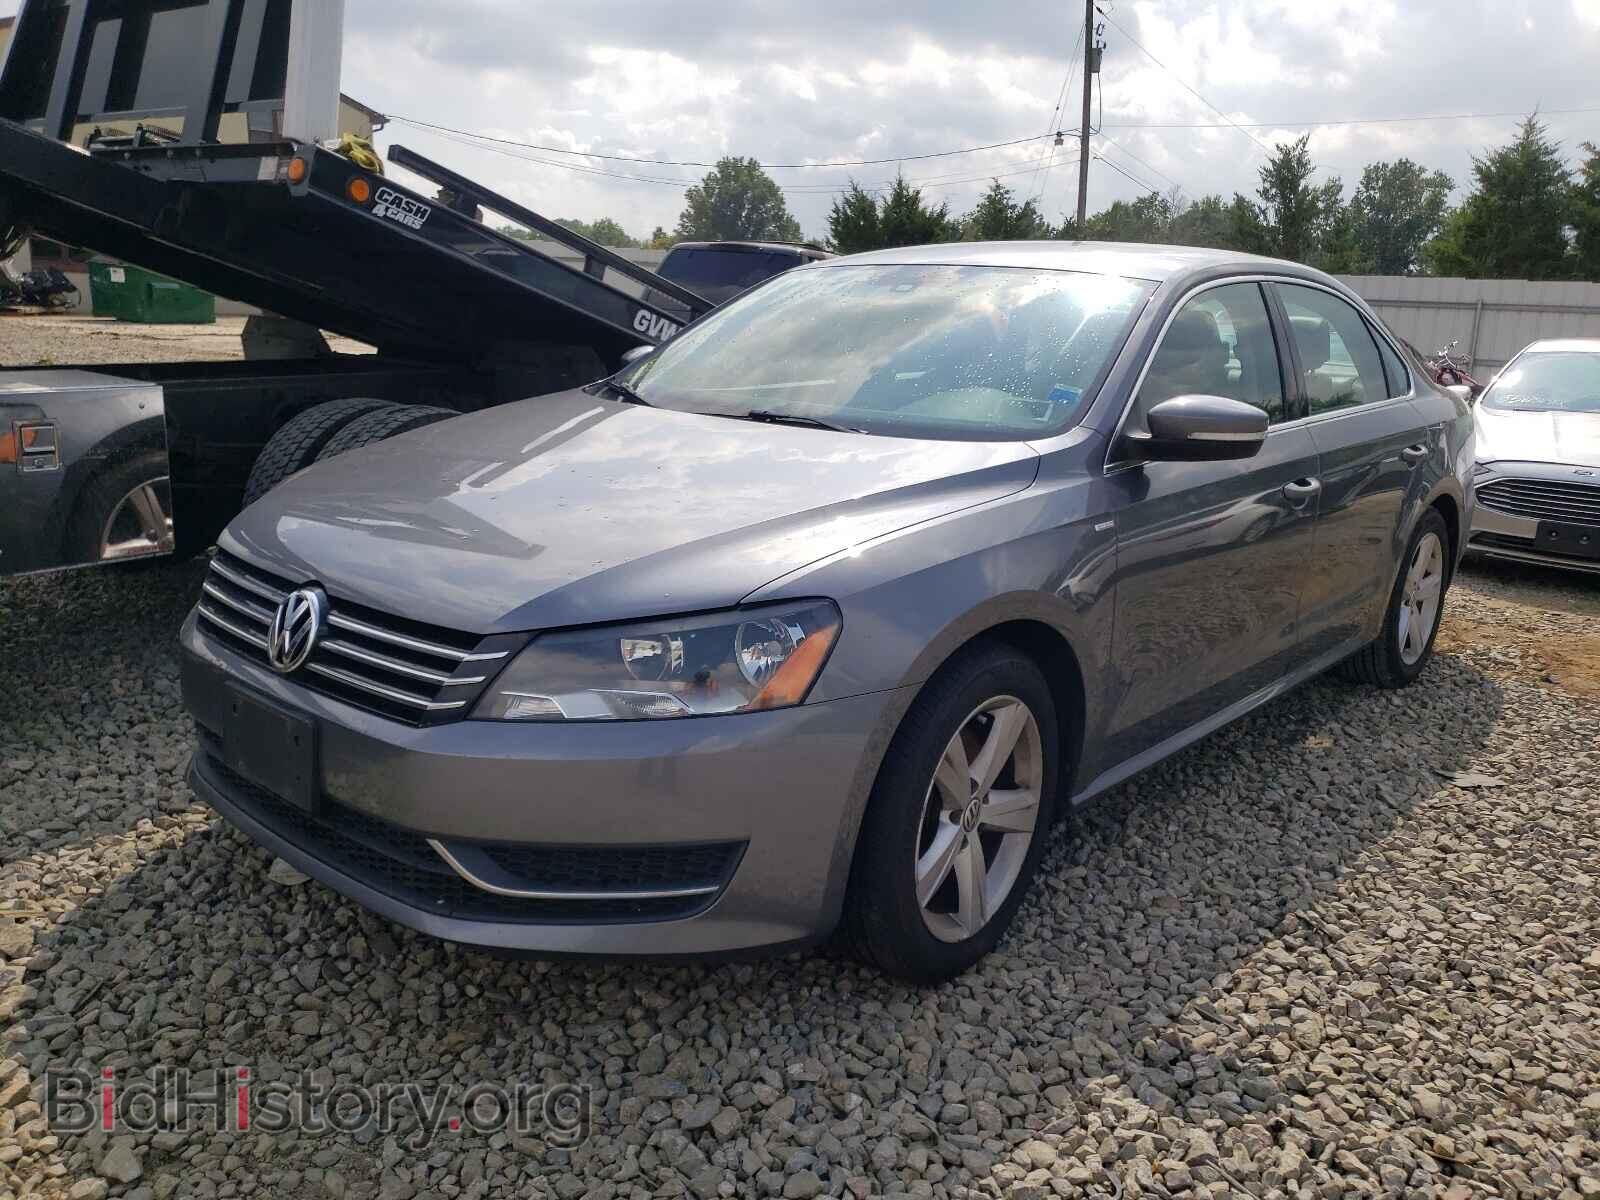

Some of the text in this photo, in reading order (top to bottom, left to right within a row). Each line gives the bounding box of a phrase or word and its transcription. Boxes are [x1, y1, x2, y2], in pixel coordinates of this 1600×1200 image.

[372, 203, 423, 230] 4 CARS
[375, 187, 431, 222] CASH
